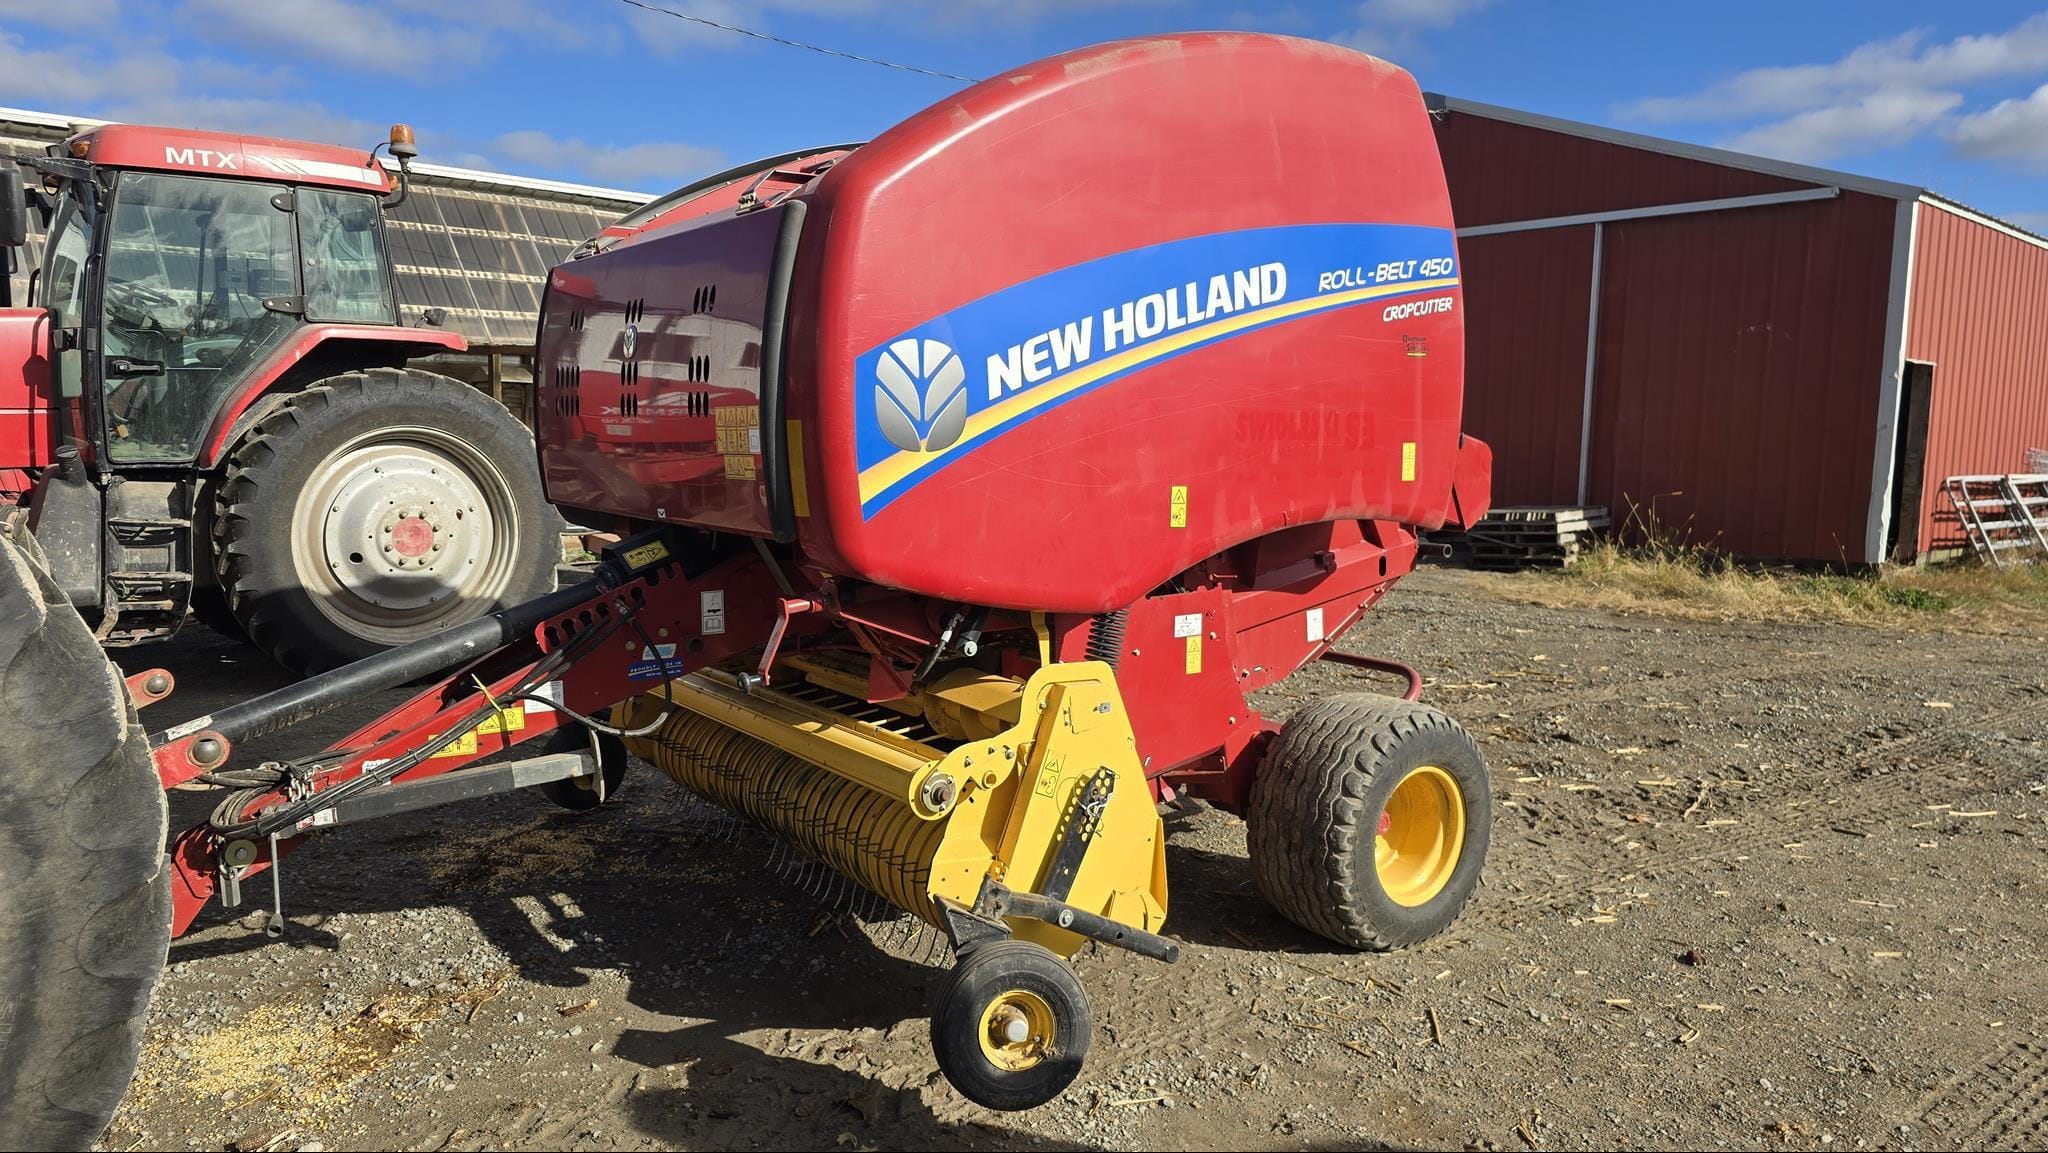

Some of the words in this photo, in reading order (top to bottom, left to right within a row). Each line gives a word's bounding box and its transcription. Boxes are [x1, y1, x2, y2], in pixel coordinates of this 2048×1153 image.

[165, 146, 238, 169] MTX
[1420, 257, 1453, 277] 450
[1383, 297, 1453, 322] CROPCUTTER
[986, 315, 1093, 401] NEW
[1102, 261, 1287, 352] HOLLAND
